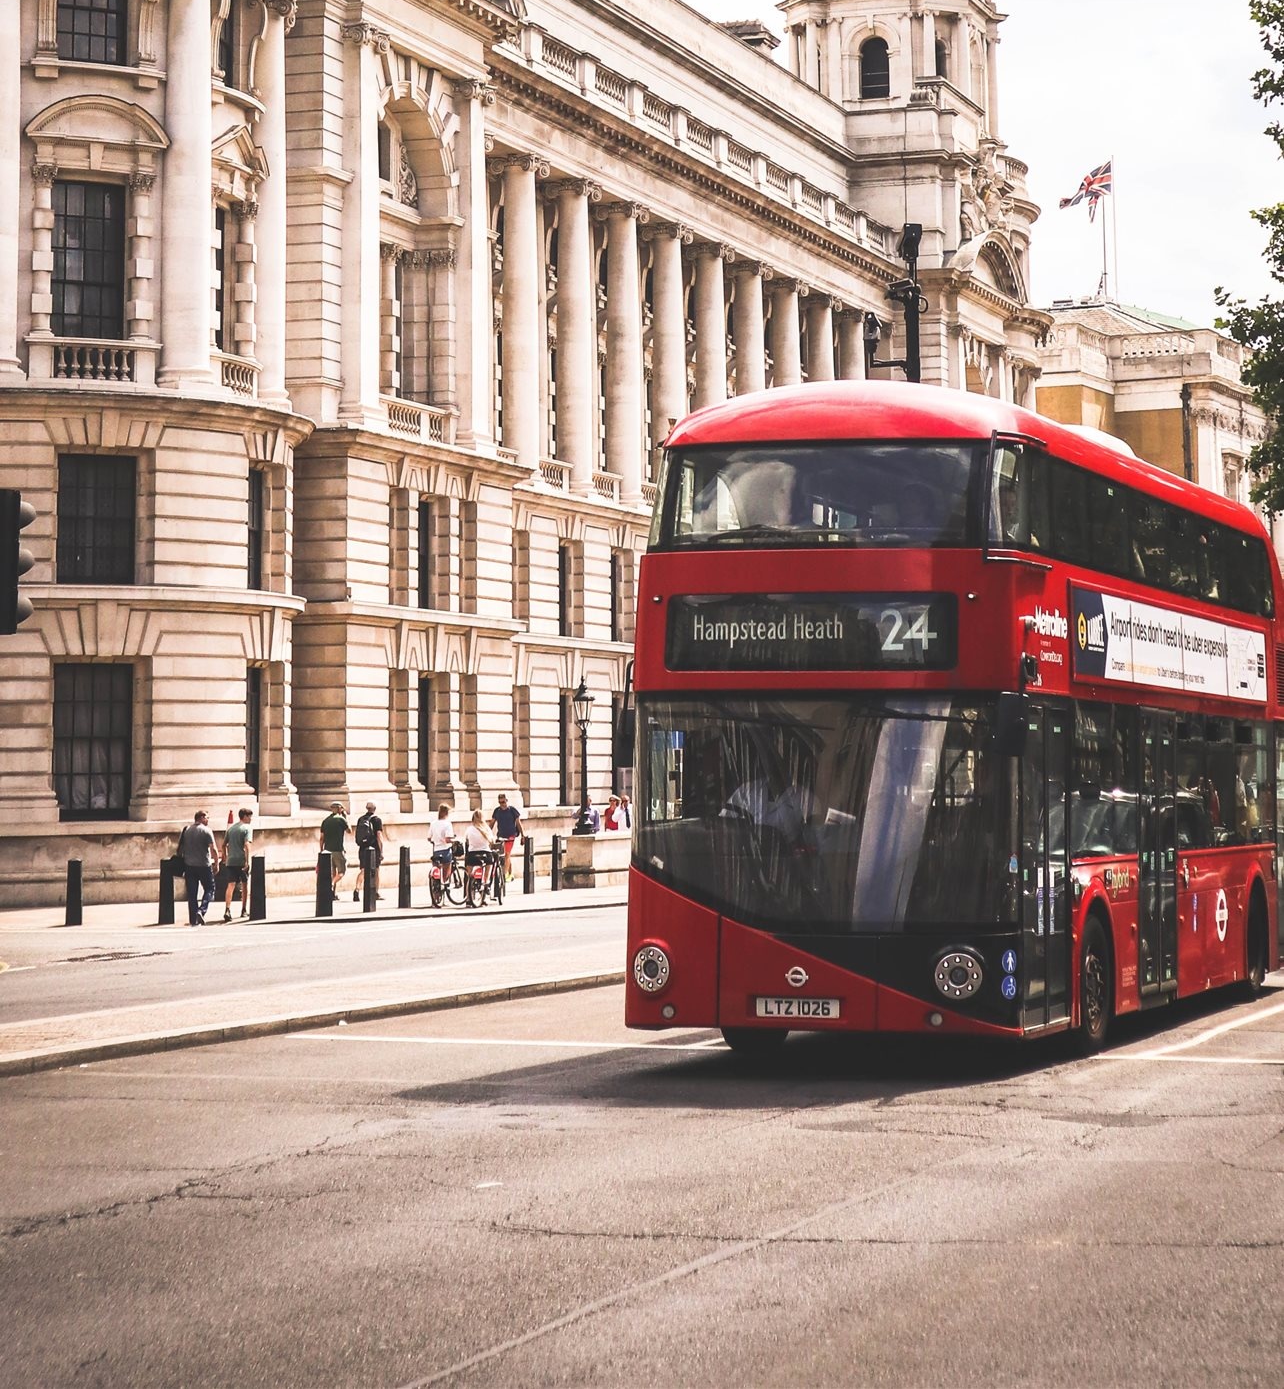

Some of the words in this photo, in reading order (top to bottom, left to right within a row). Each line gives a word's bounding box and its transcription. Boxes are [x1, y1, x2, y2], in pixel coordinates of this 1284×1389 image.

[693, 614, 786, 648] Hampstead
[794, 612, 843, 640] Heath
[880, 605, 938, 651] 24
[1033, 604, 1068, 639] Metroline
[1110, 610, 1132, 642] Airport
[1133, 616, 1147, 641] rides
[1148, 620, 1162, 645] don't
[1163, 625, 1177, 647] need
[1184, 628, 1191, 651] be
[1192, 631, 1203, 653] uber
[1204, 637, 1228, 661] expensive
[765, 999, 794, 1015] LTZ
[798, 1000, 831, 1016] 1026
